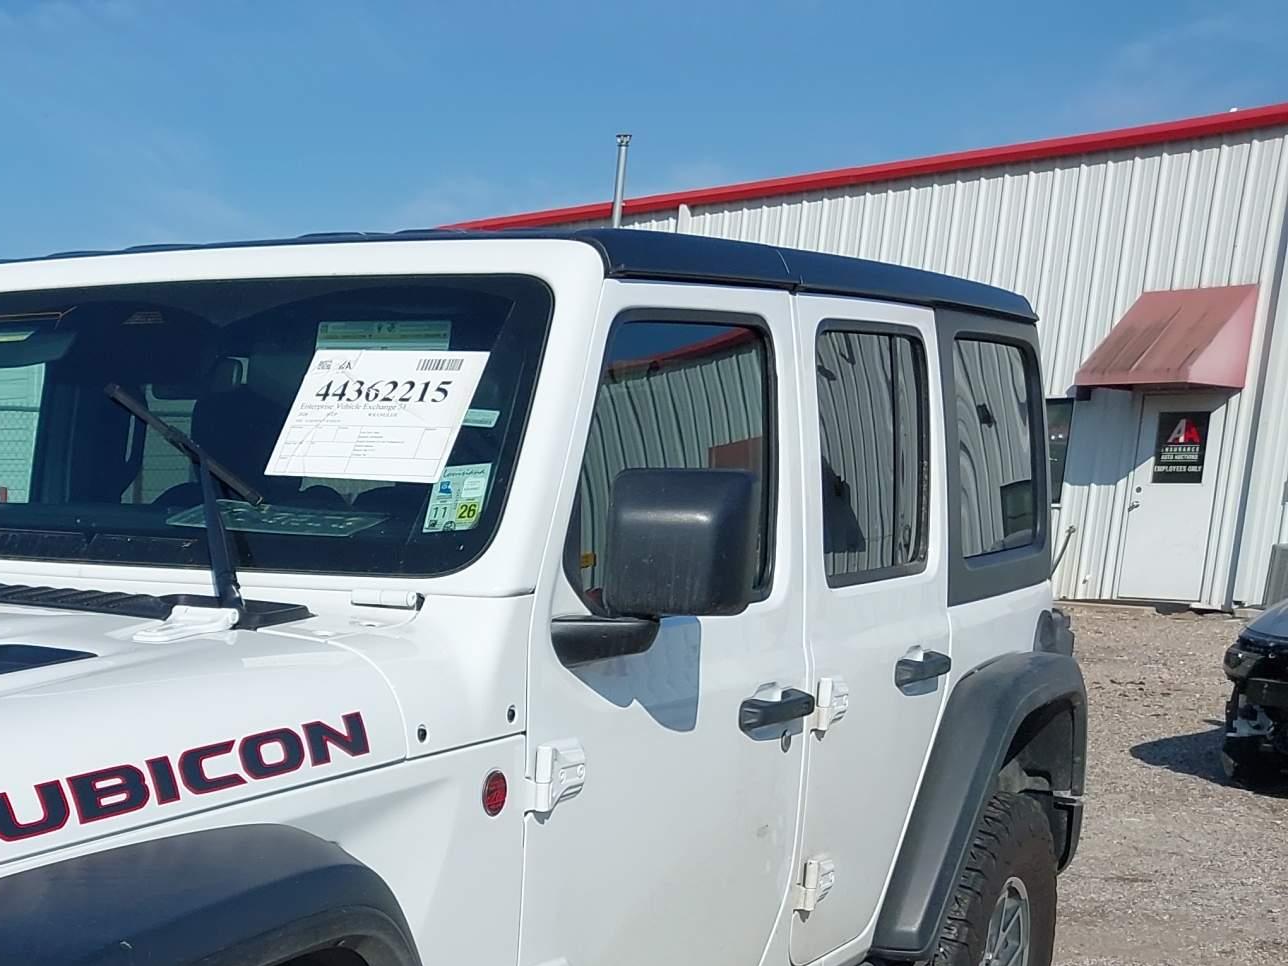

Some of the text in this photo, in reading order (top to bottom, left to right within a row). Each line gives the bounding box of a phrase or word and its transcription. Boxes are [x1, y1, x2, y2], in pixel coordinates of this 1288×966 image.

[315, 380, 453, 402] 44362215
[432, 503, 477, 519] 11 26
